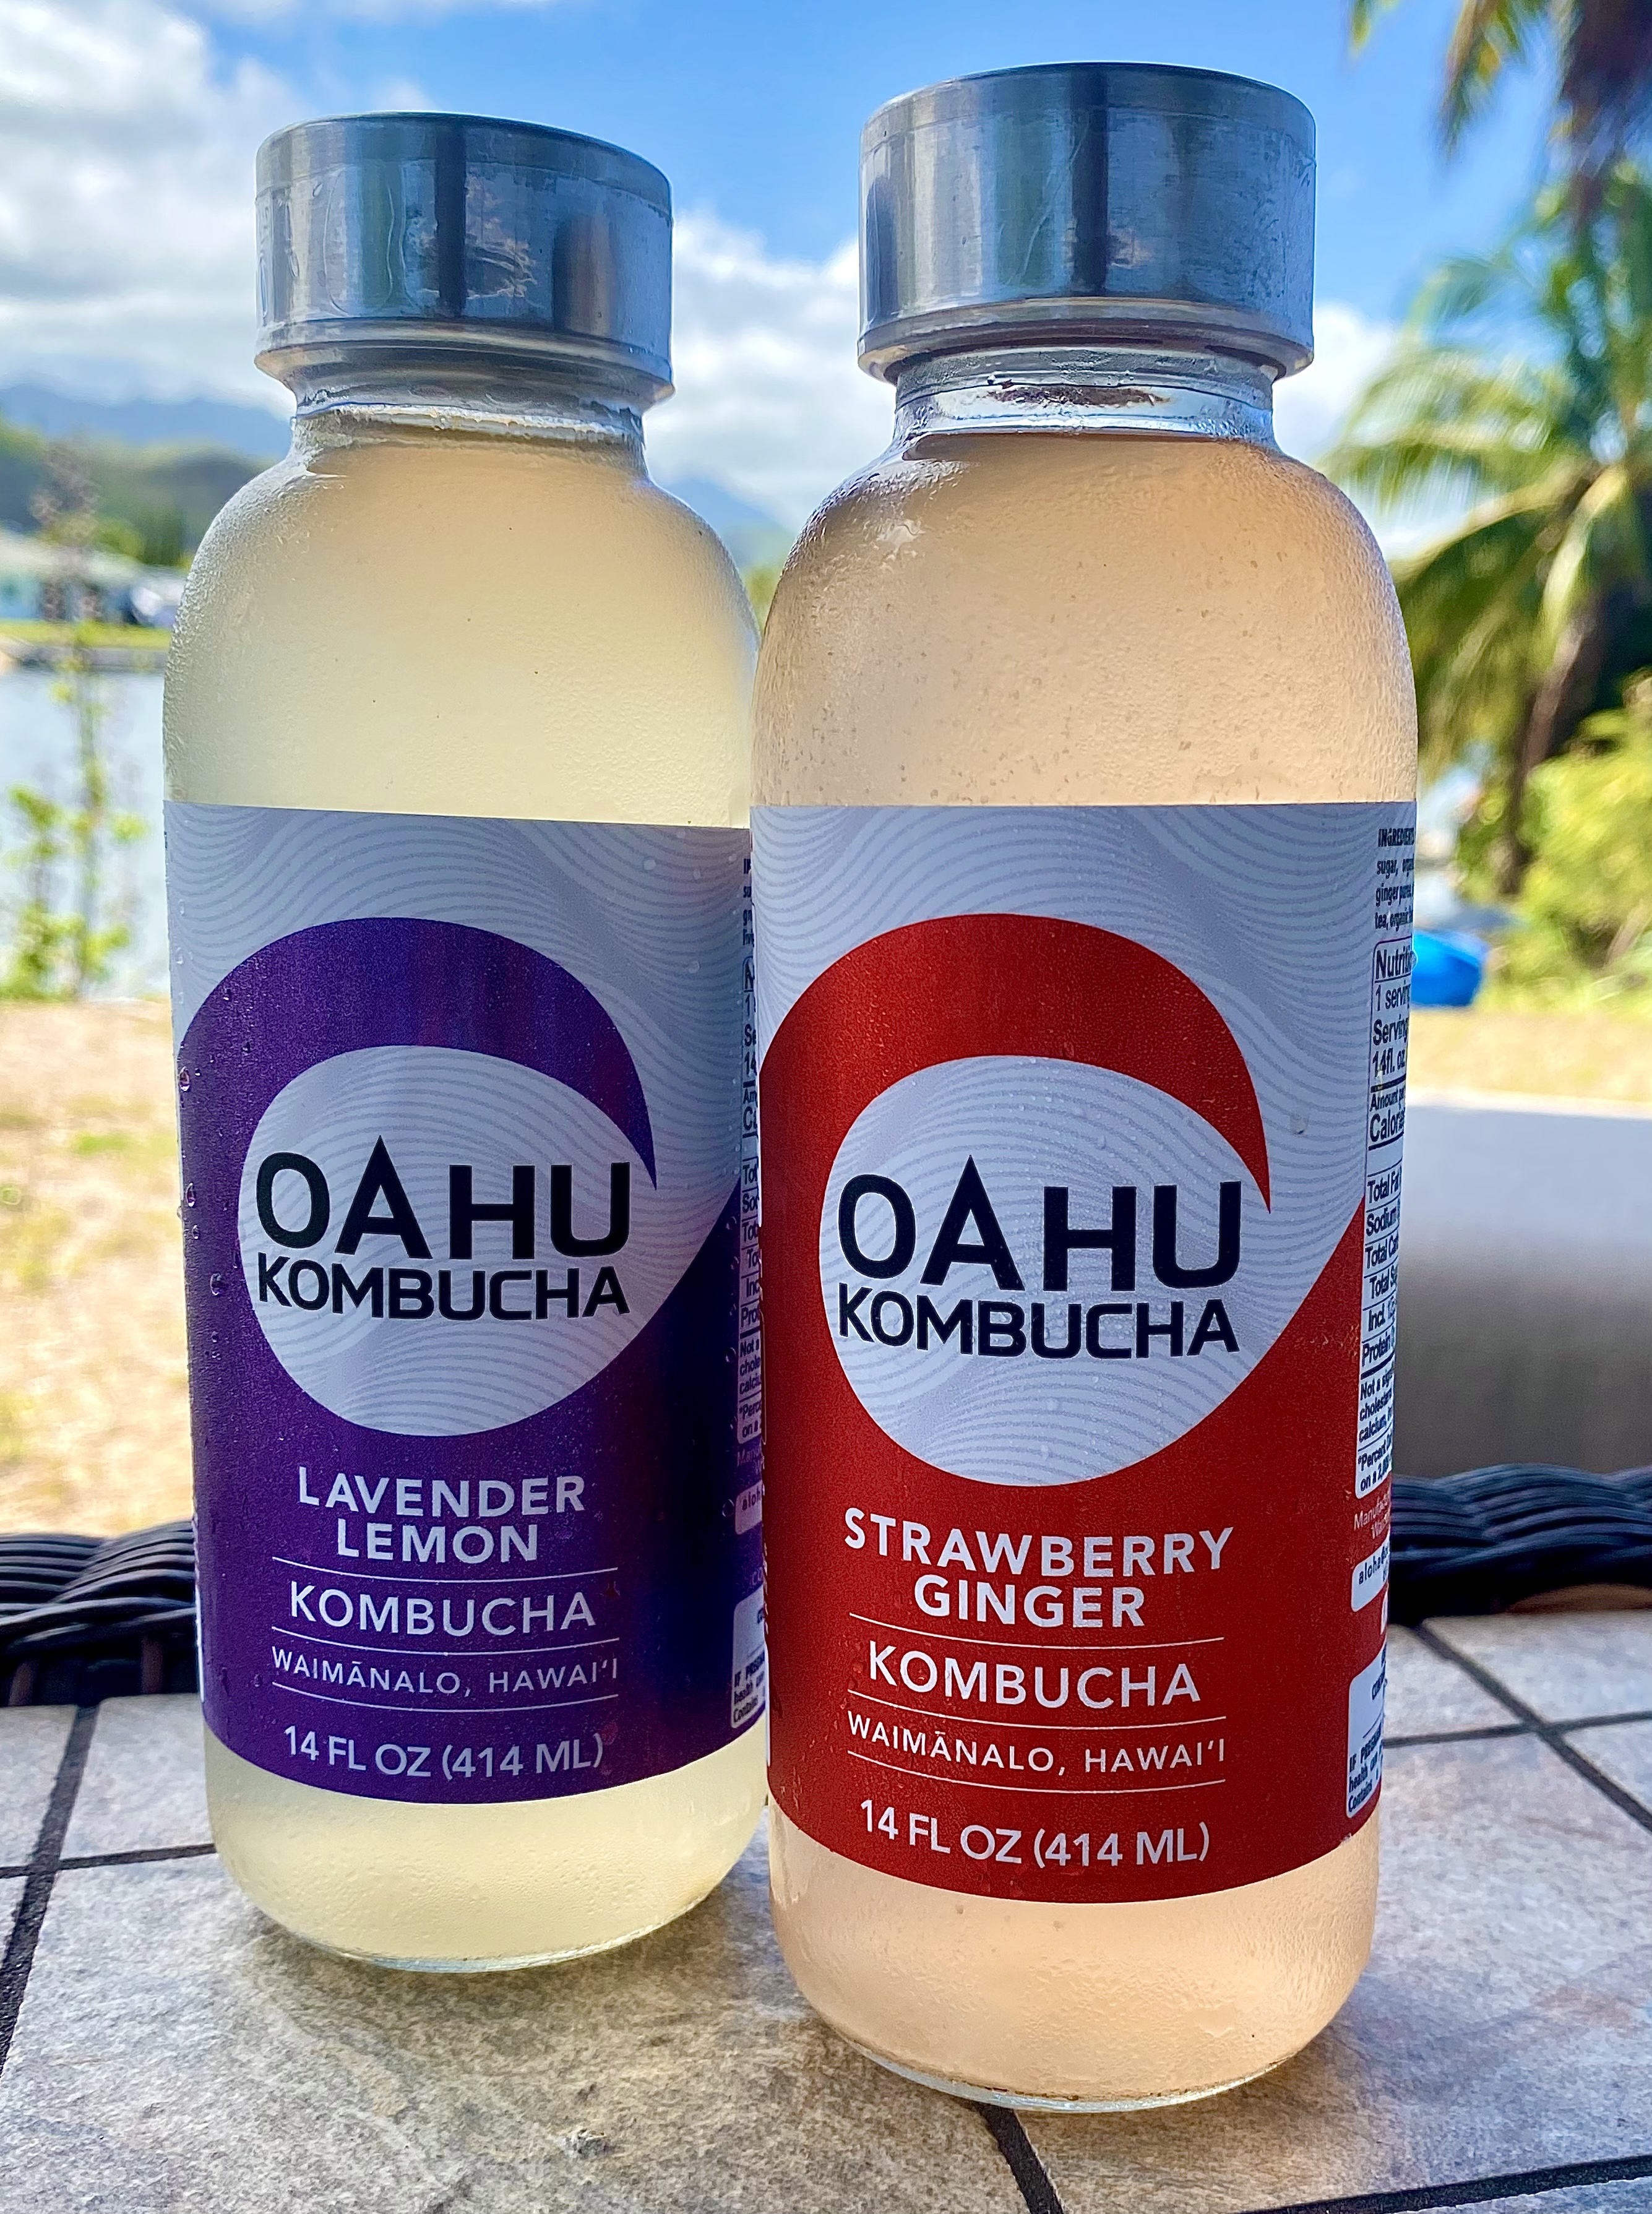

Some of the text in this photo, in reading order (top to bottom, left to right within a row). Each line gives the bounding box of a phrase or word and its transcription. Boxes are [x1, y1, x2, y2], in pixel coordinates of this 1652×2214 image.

[1375, 883, 1400, 907] ginger
[1375, 984, 1381, 1012] 1
[256, 1135, 630, 1260] OAHU
[1367, 1174, 1390, 1204] Total
[838, 1154, 1242, 1291] OAHU
[1364, 1238, 1387, 1269] Total
[257, 1252, 630, 1320] KOMBUCHA
[1369, 1268, 1390, 1299] Total
[838, 1283, 1240, 1359] KOMBUCHA
[298, 1465, 585, 1518] LAVENDER
[1360, 1474, 1371, 1492] on
[337, 1518, 538, 1564] LEMON
[844, 1507, 1234, 1579] STRAWBERRY
[290, 1580, 596, 1637] KOMBUCHA
[914, 1574, 1145, 1629] GINGER
[272, 1645, 472, 1697] WAIMĀNALO,
[869, 1640, 1201, 1710] KOMBUCHA
[283, 1725, 604, 1781] 14 FL OZ (414 ML)
[847, 1710, 1066, 1777] WAIMĀNALO,
[860, 1799, 1210, 1869] 14 FL OZ (414 ML)
